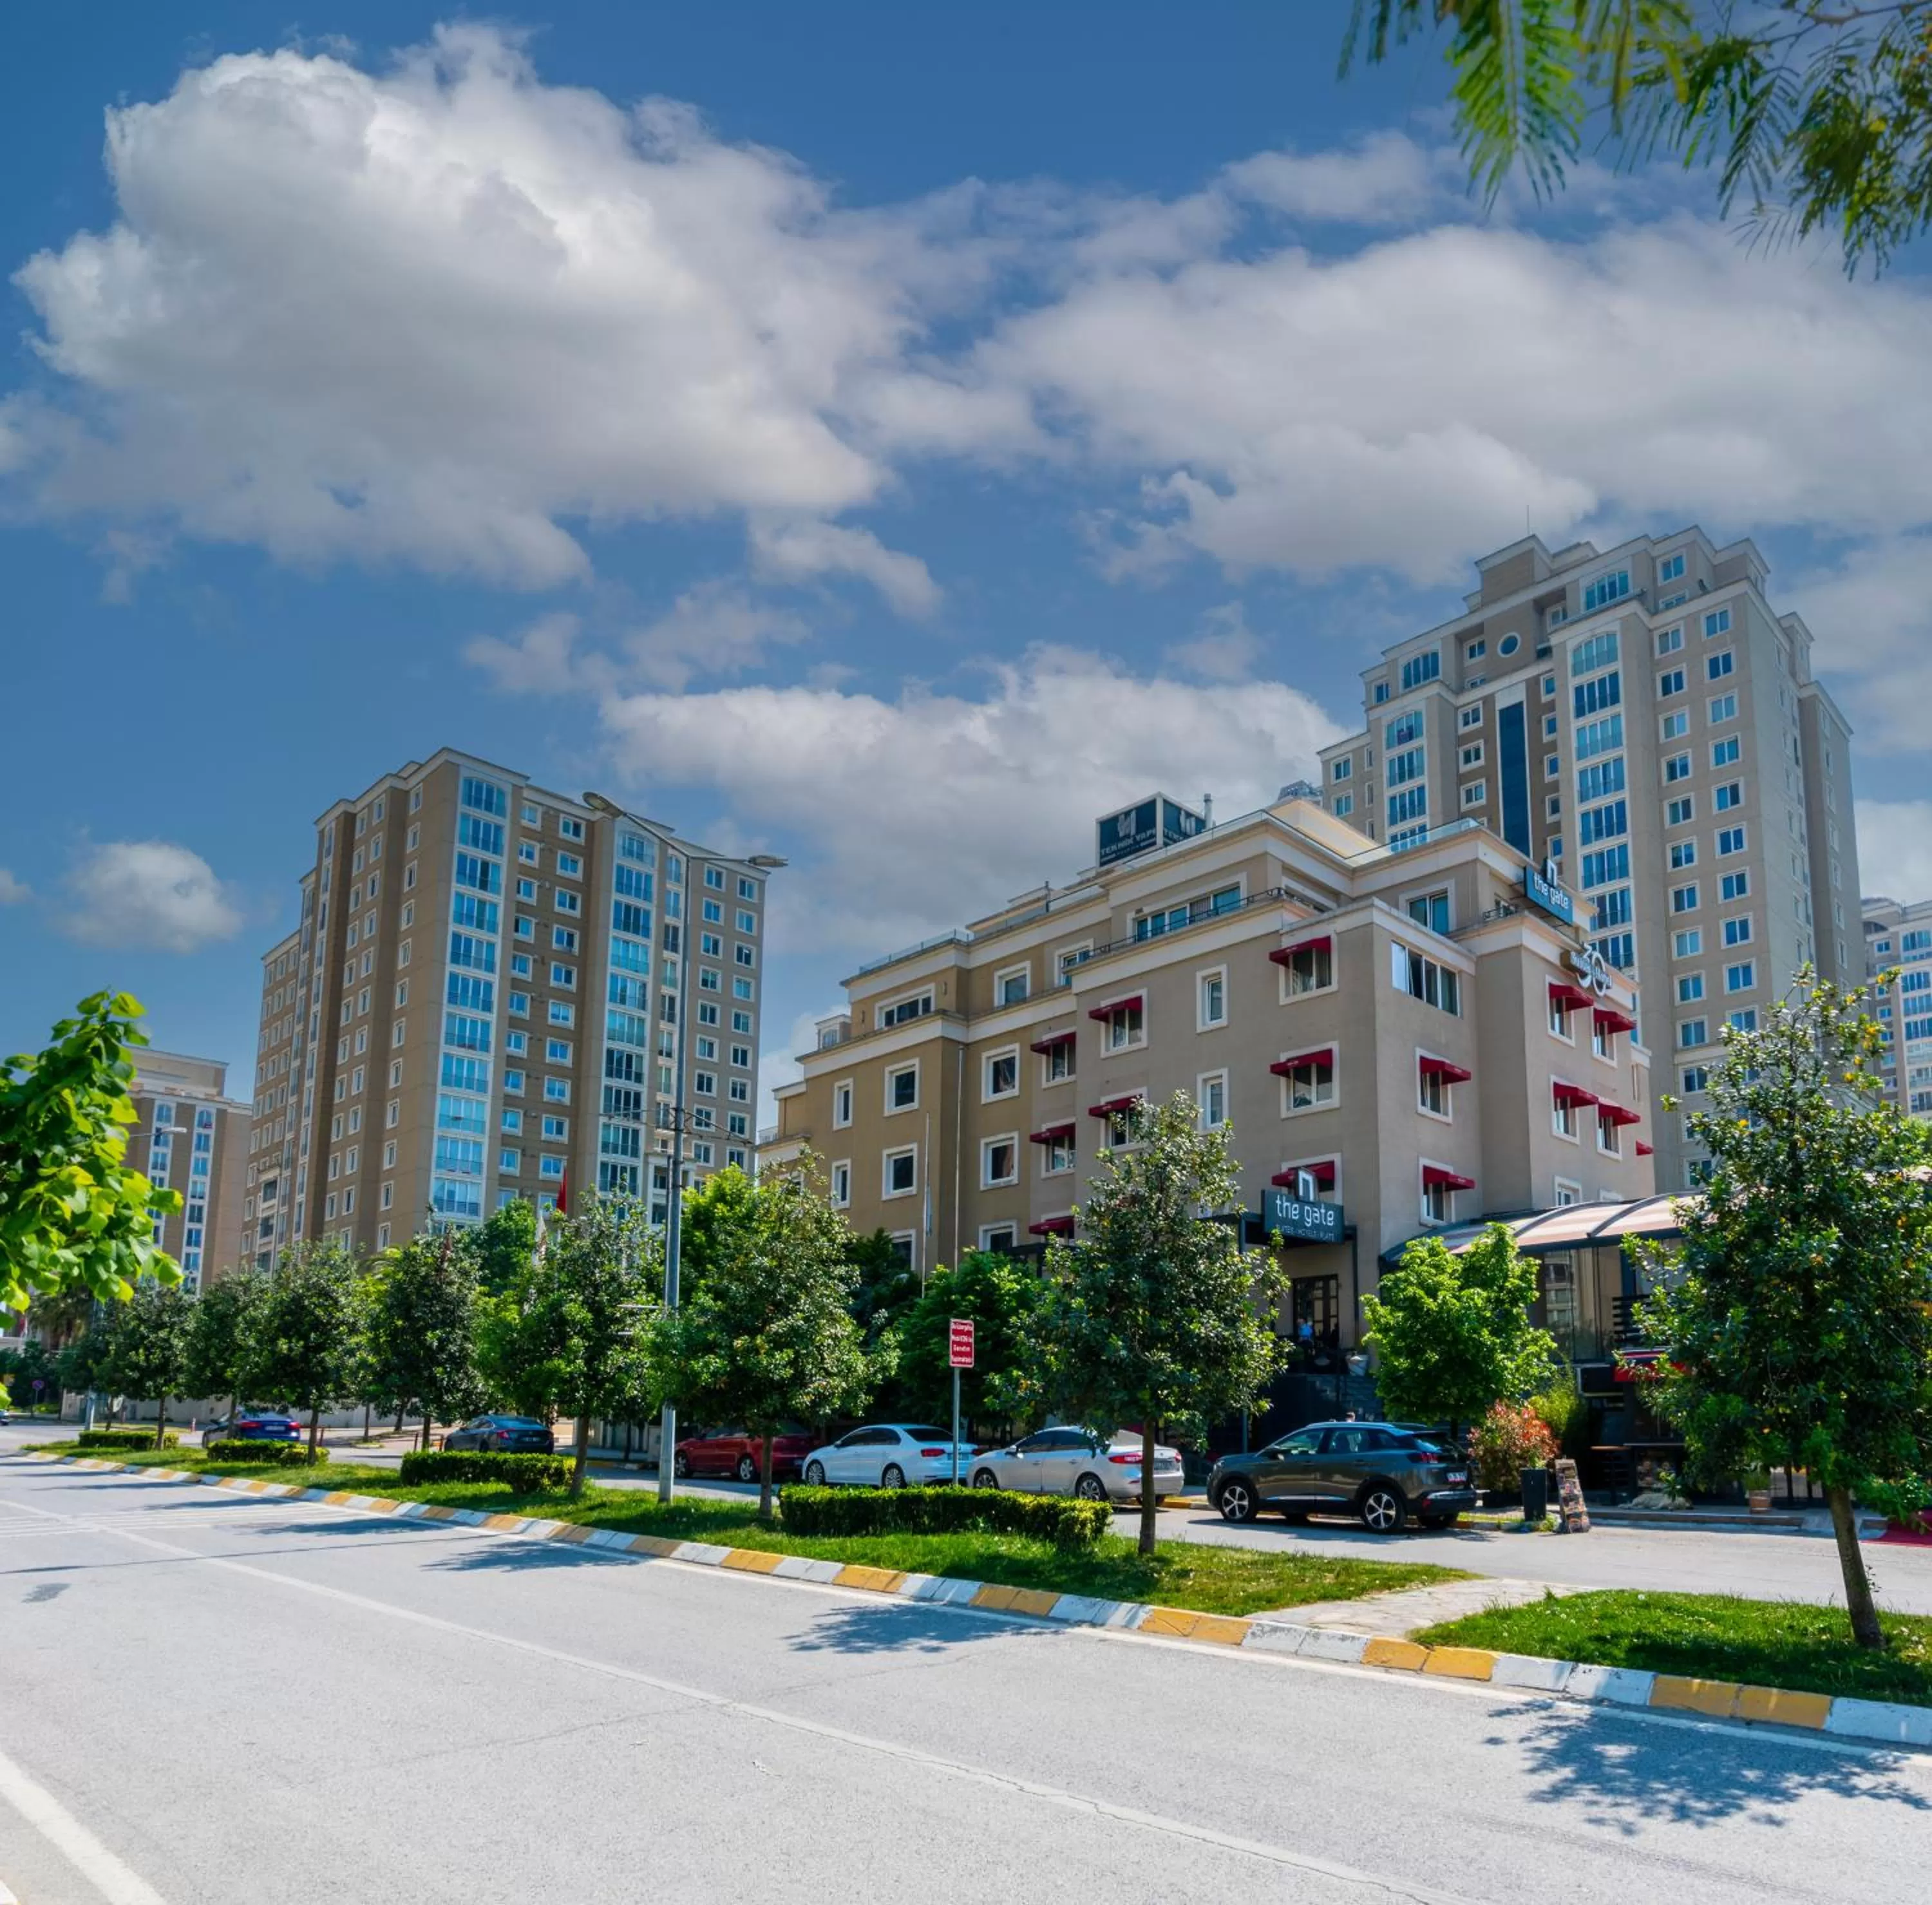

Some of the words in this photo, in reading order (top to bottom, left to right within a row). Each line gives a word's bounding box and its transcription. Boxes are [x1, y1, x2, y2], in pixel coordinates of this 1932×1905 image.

[1535, 873, 1548, 896] the
[1550, 887, 1569, 909] gate
[1276, 1195, 1299, 1219] the
[1304, 1203, 1334, 1227] gate
